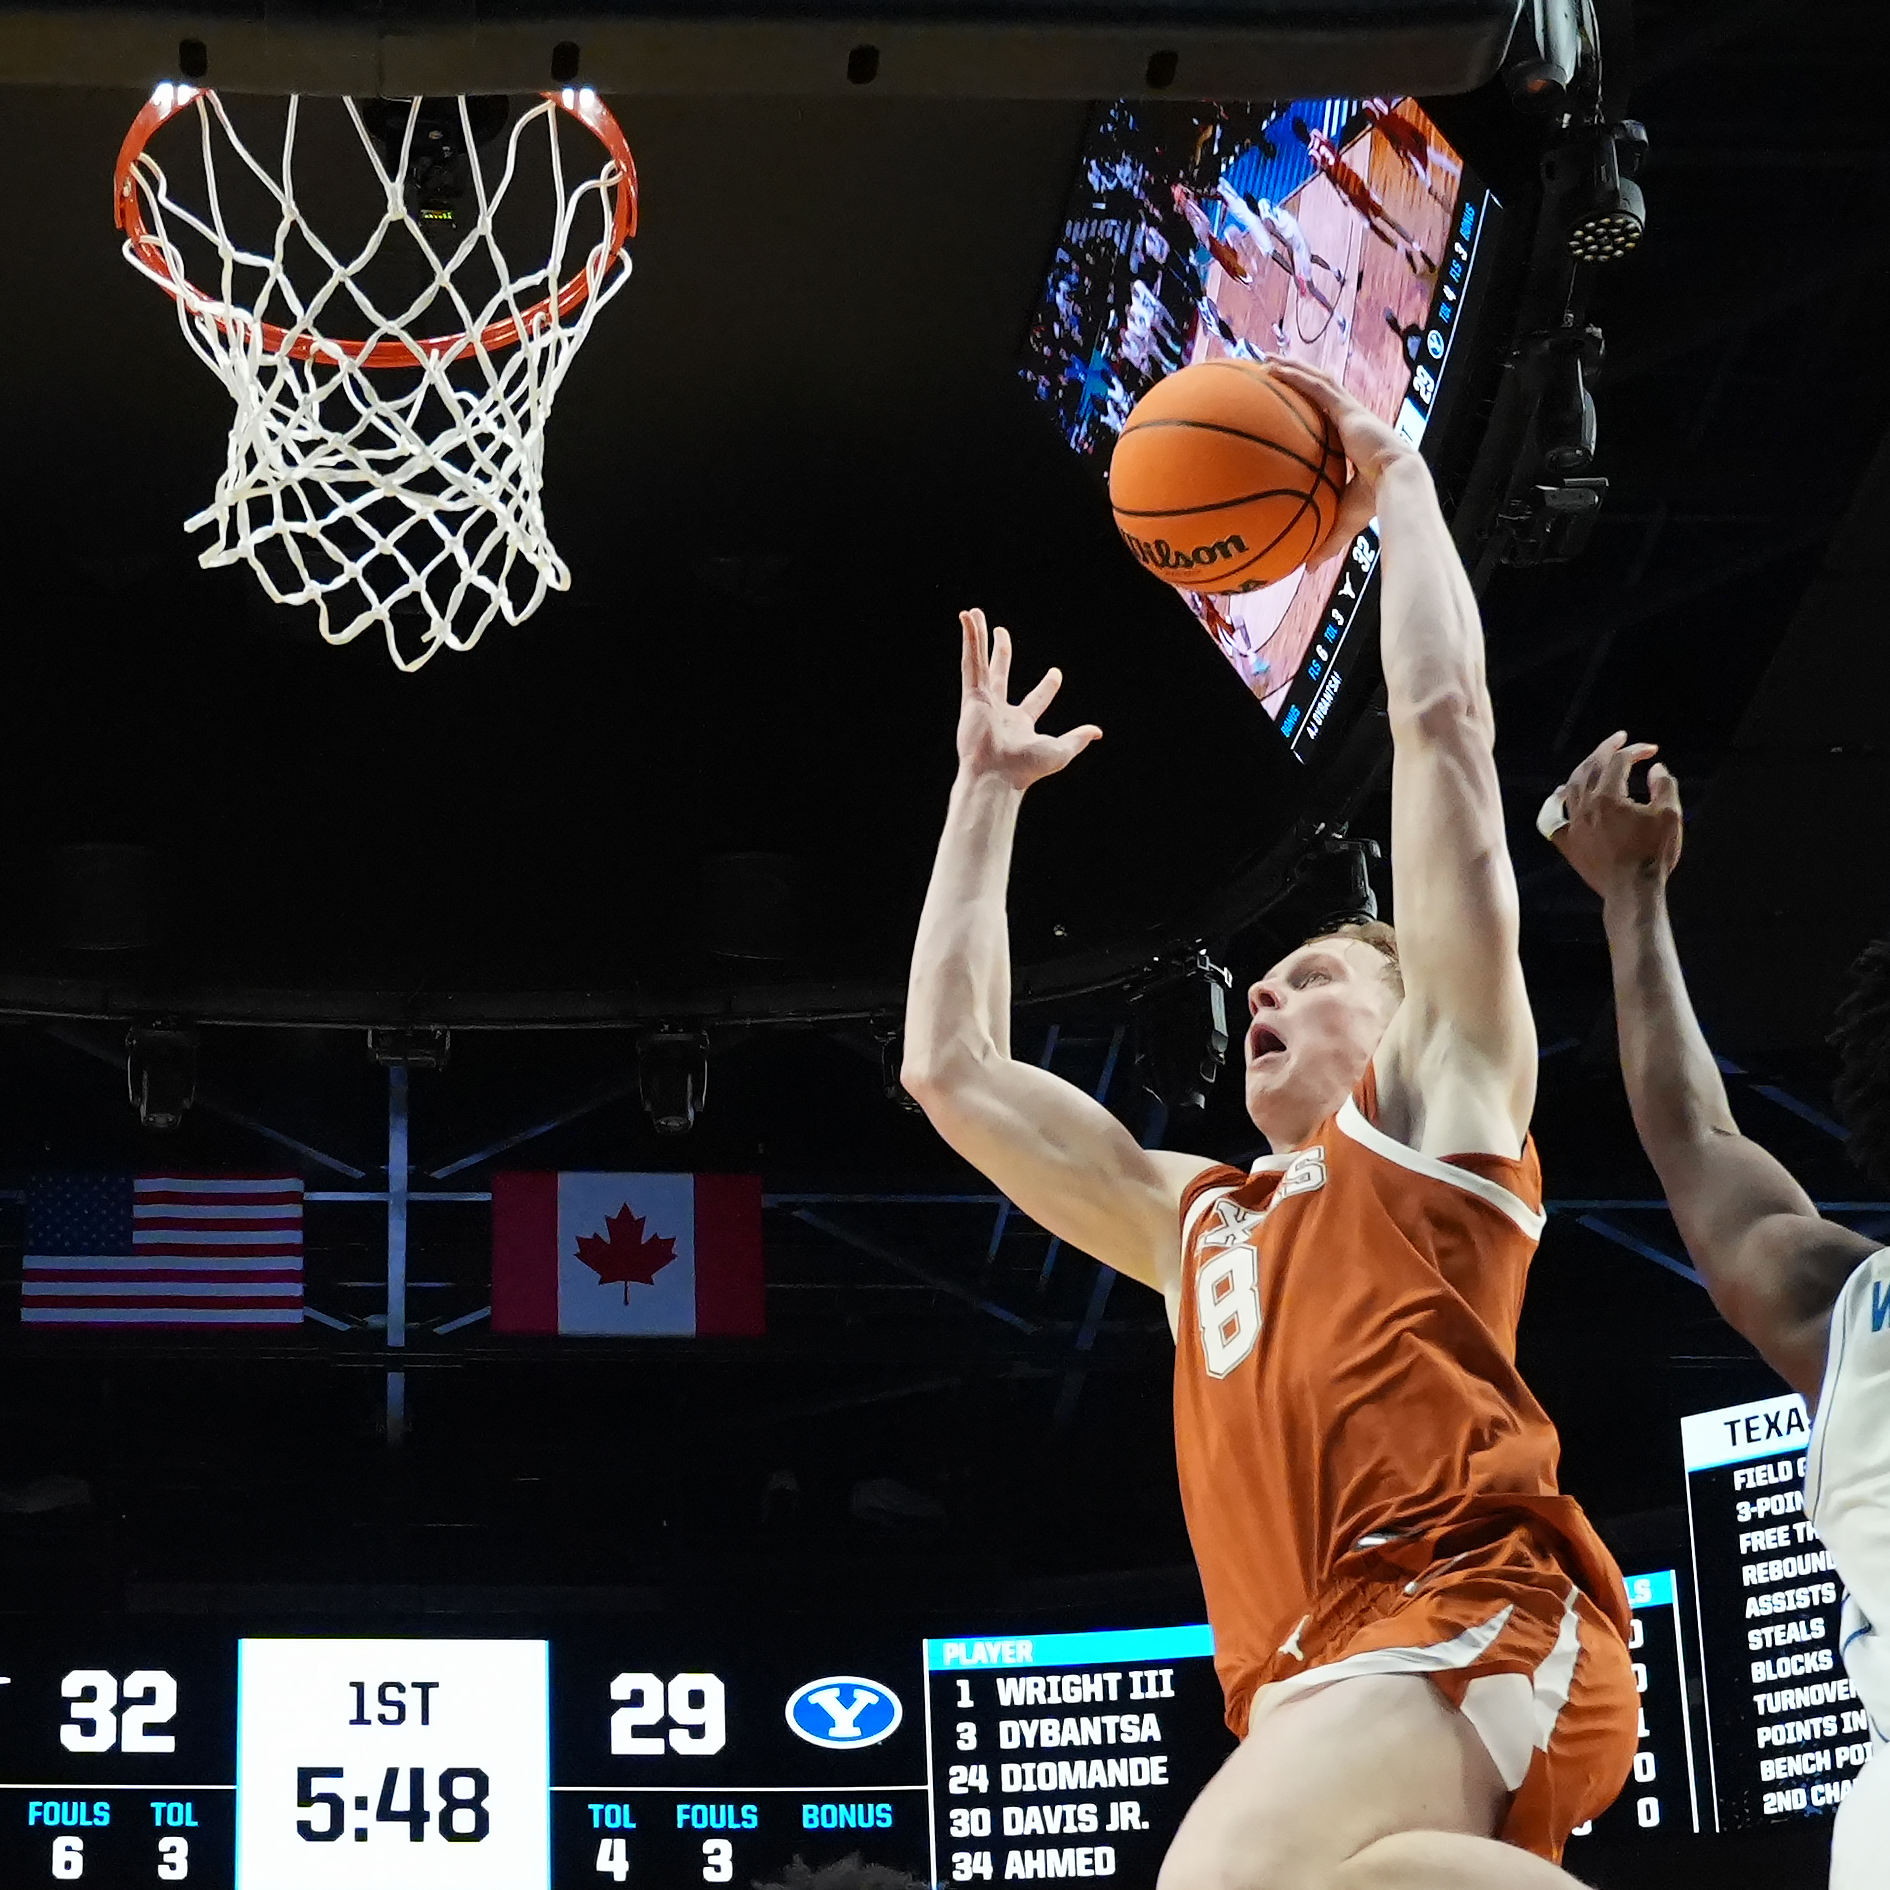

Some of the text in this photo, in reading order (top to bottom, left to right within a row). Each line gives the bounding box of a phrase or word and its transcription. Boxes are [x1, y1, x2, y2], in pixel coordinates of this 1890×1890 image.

[1280, 703, 1301, 738] BONUS
[1196, 1244, 1262, 1380] 8
[944, 1640, 1032, 1665] PLAYER
[349, 1681, 439, 1725] 1ST
[956, 1668, 1174, 1707] 1 WRIGHT III
[60, 1670, 176, 1752] 32
[610, 1673, 725, 1755] 29
[956, 1713, 1161, 1750] 3 DYBANTSA
[948, 1755, 1168, 1794] 24 DIOMANDE
[28, 1801, 110, 1826] FOULS
[150, 1802, 198, 1826] TOL
[296, 1767, 489, 1842] 5:48
[588, 1803, 892, 1829] TOL FOULS BONUS
[949, 1801, 1149, 1837] 30 DAVIS JR.
[52, 1836, 188, 1880] 6 3
[596, 1838, 732, 1882] 4 3
[951, 1846, 1115, 1881] 34 AHMED
